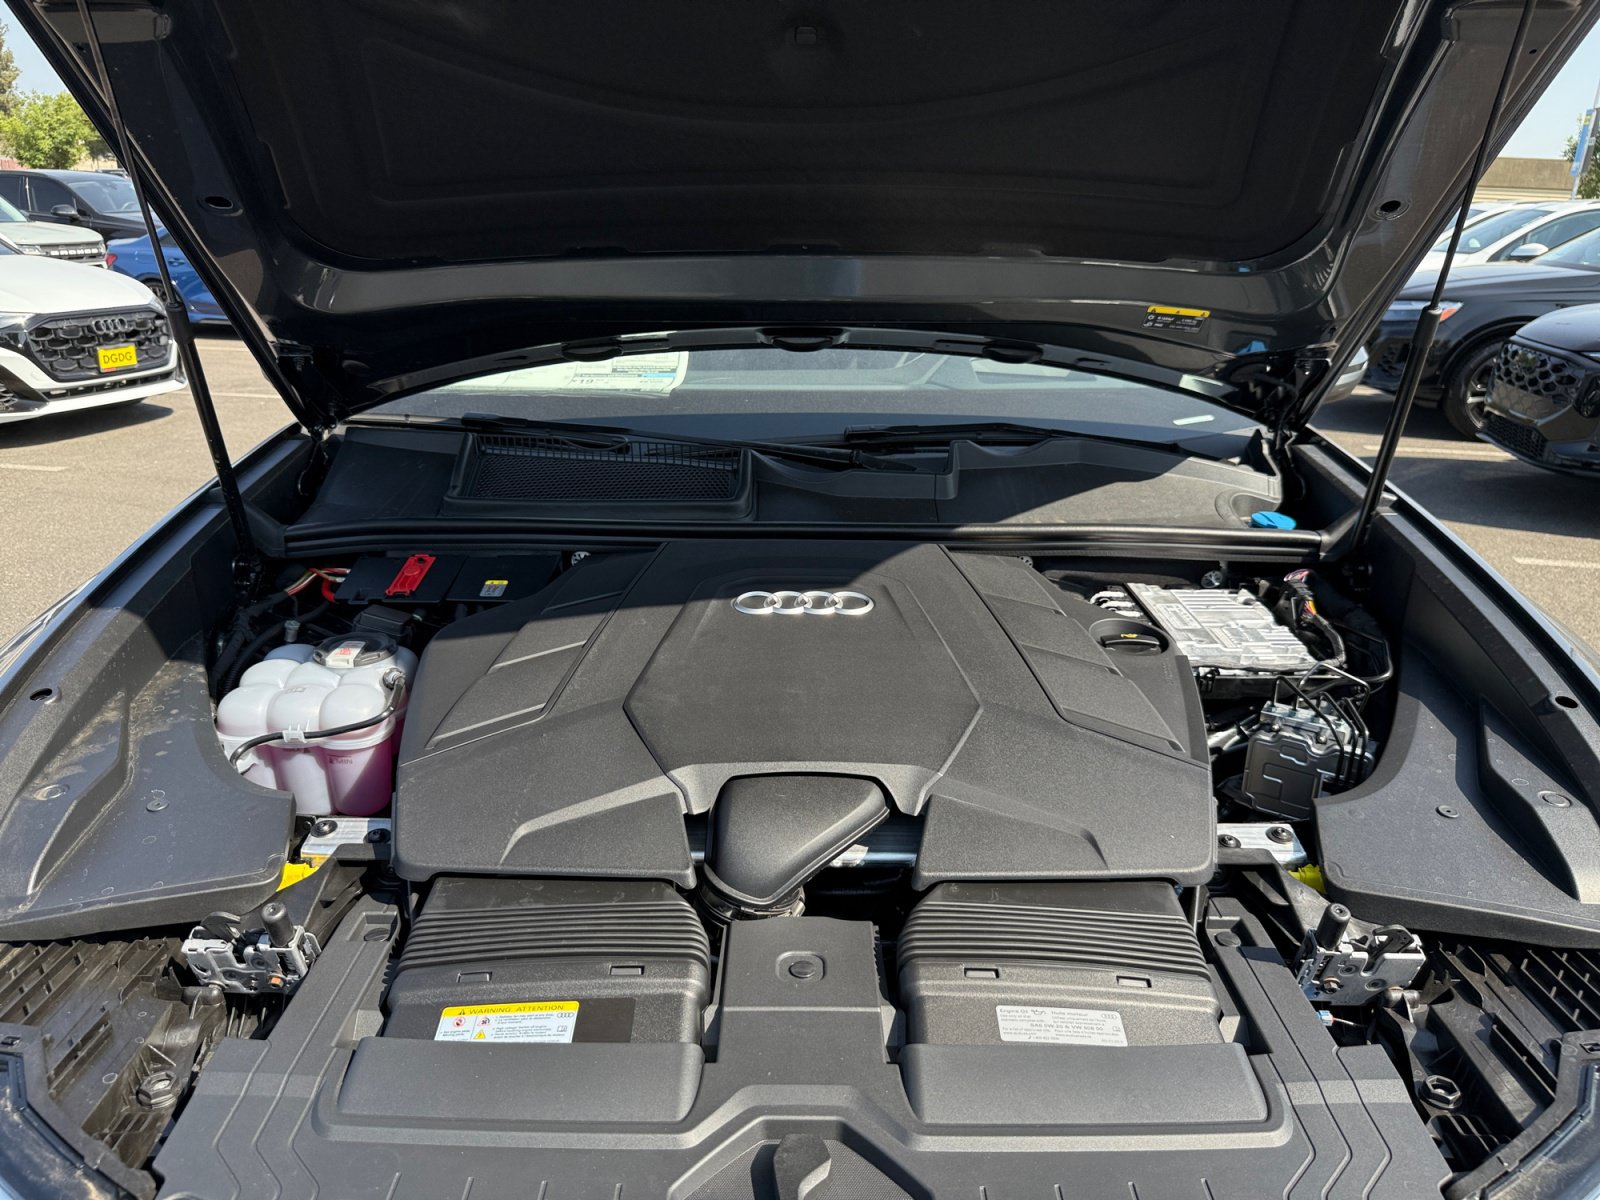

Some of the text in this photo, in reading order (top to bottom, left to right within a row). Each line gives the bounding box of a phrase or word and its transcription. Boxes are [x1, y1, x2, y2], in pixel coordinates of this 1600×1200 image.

[103, 351, 133, 364] DGDG
[469, 1004, 564, 1015] WARNING ATTENTION
